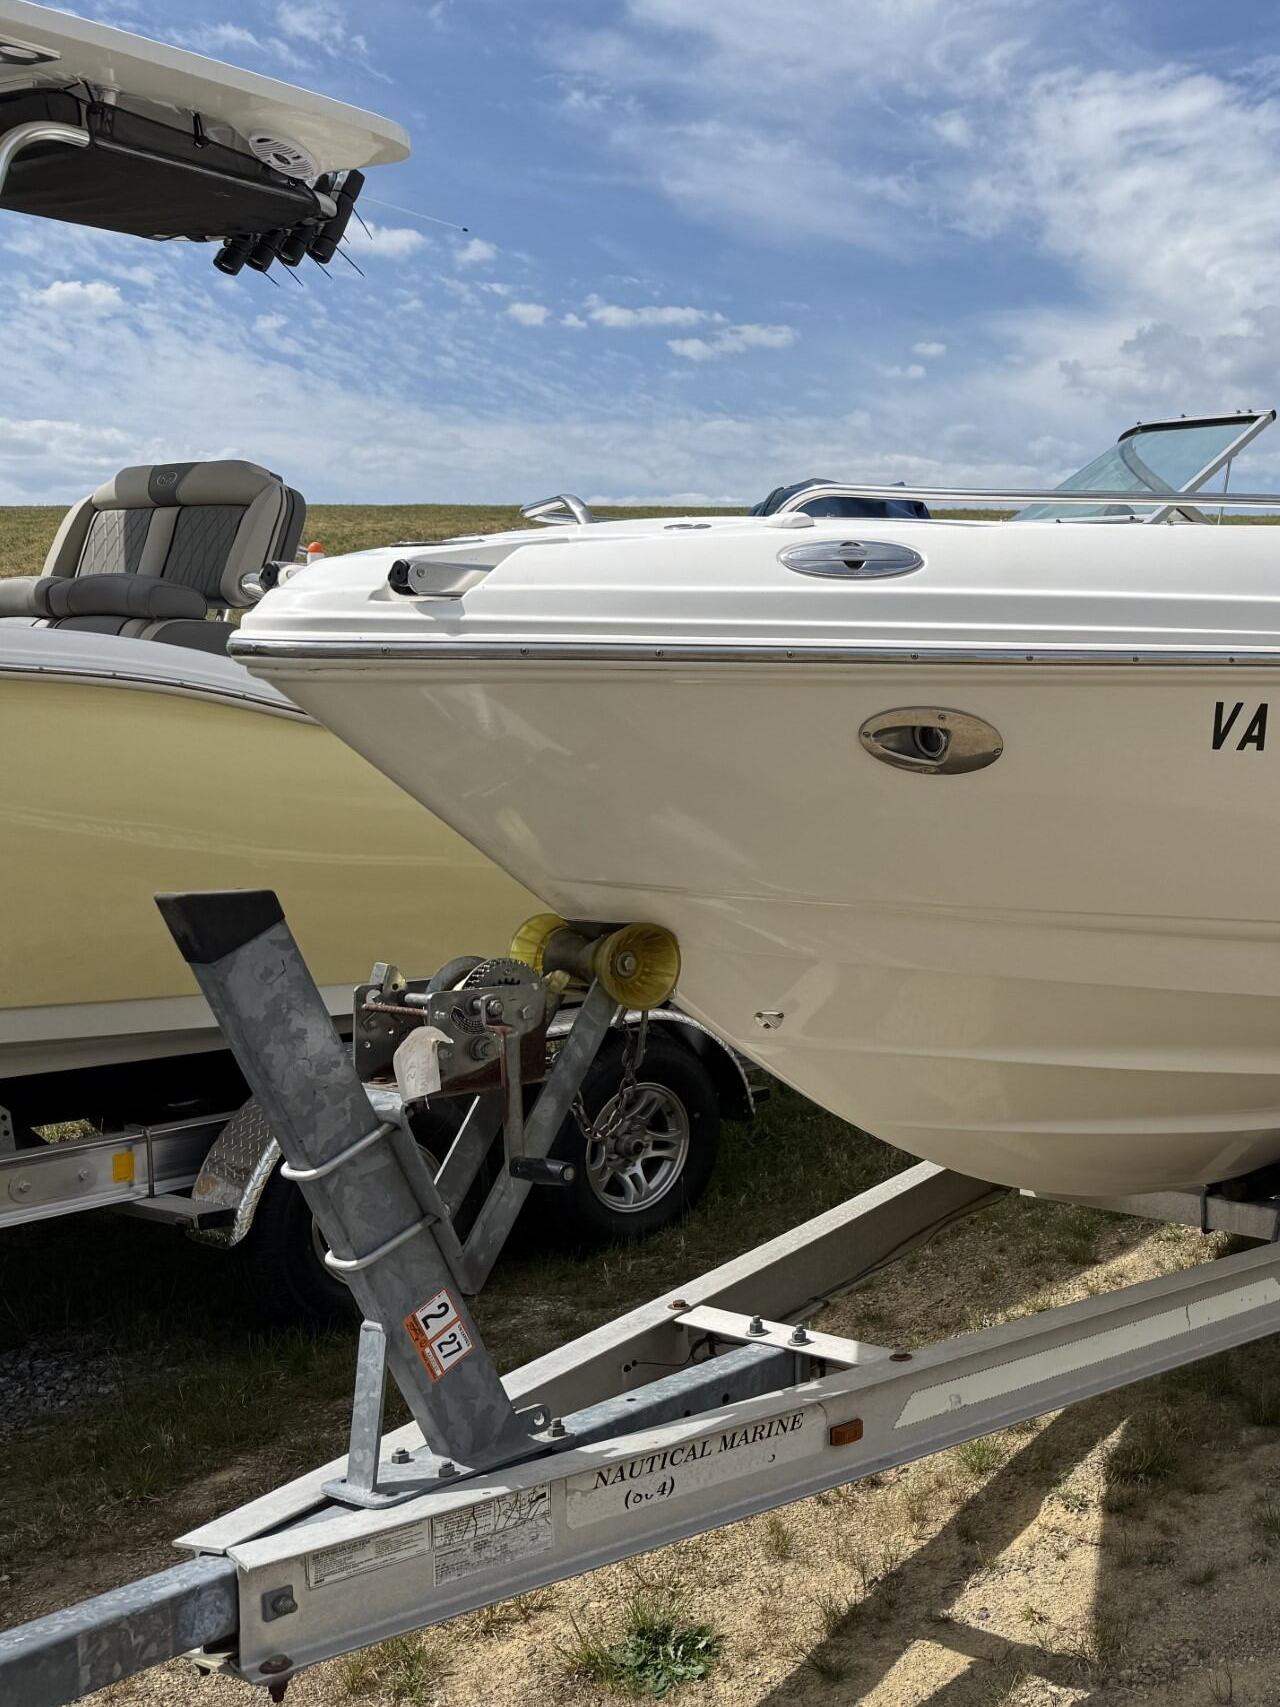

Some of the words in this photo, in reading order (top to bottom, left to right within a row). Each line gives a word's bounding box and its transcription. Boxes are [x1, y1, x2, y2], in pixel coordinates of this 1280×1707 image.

[1212, 702, 1268, 750] VA
[422, 1302, 450, 1329] 2
[437, 1333, 463, 1359] 27
[593, 1441, 712, 1489] NAUTICAL
[719, 1414, 804, 1452] MARINE
